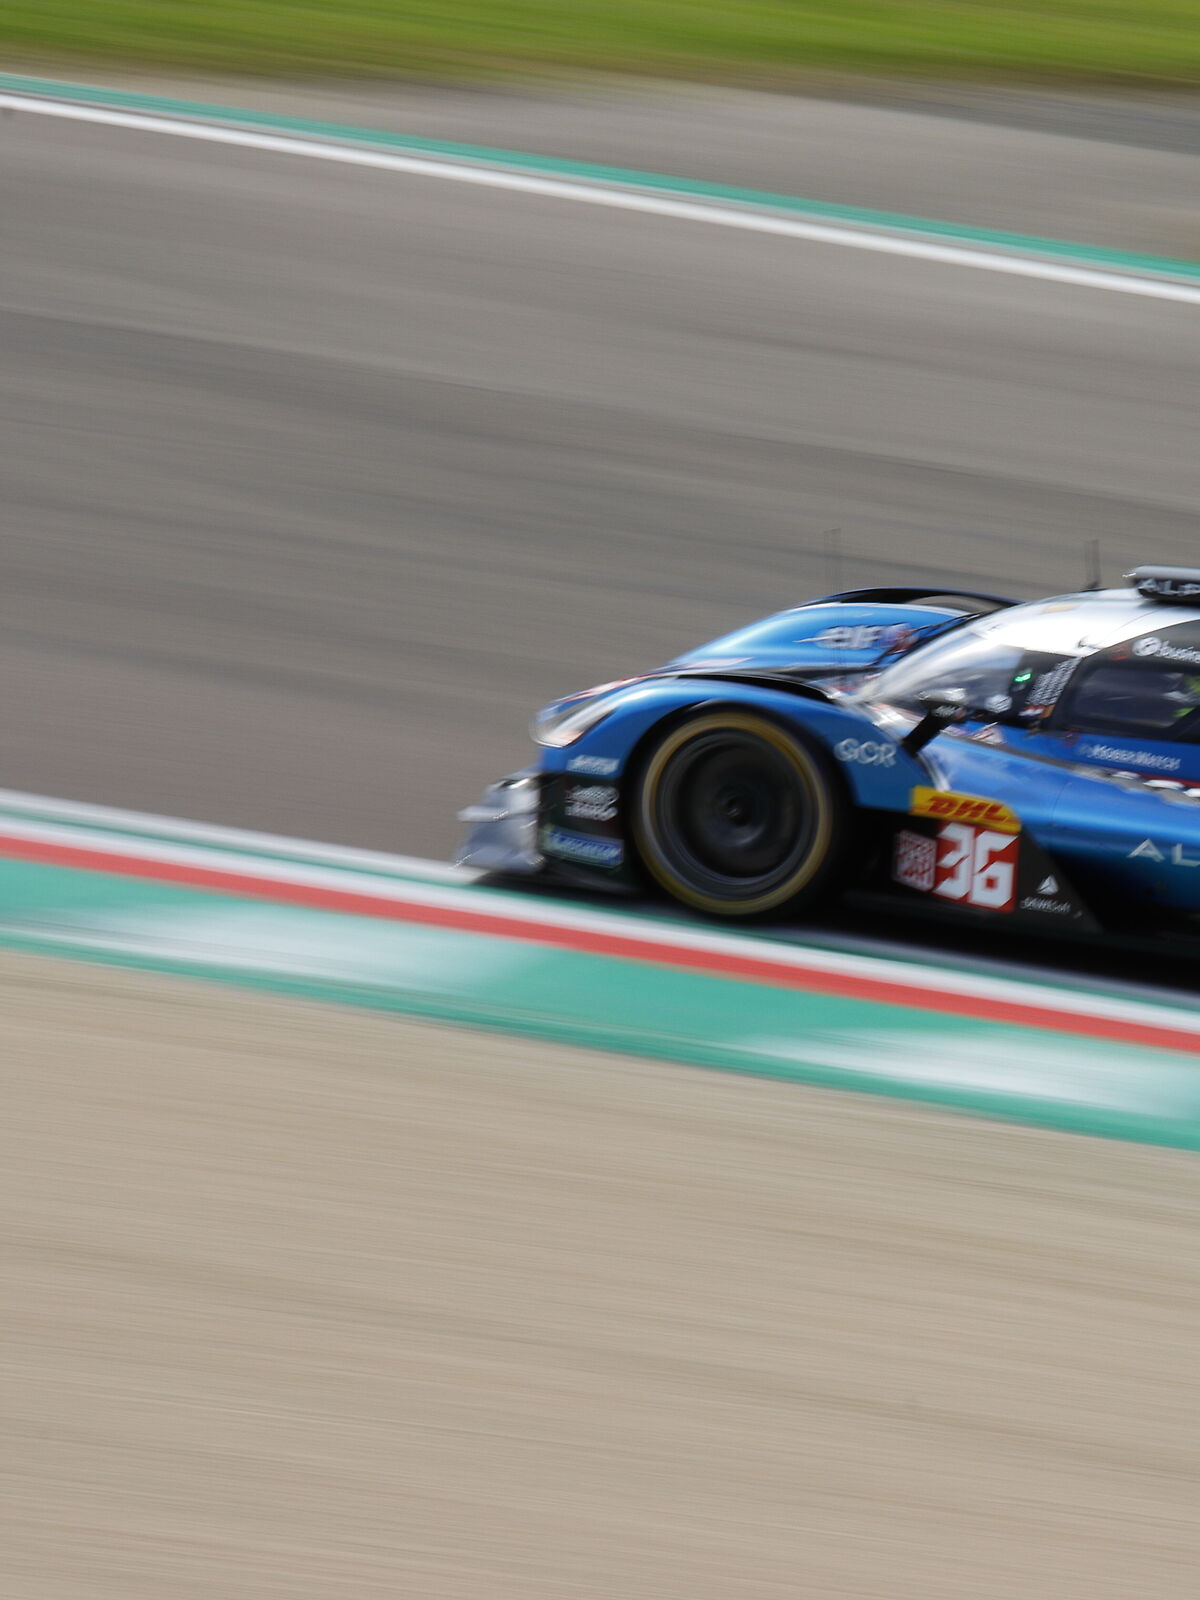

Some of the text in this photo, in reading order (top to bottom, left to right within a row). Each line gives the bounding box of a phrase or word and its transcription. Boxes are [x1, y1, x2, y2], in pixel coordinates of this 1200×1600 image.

[834, 738, 897, 768] GCR
[928, 796, 1009, 822] DHL
[932, 822, 1019, 909] 36
